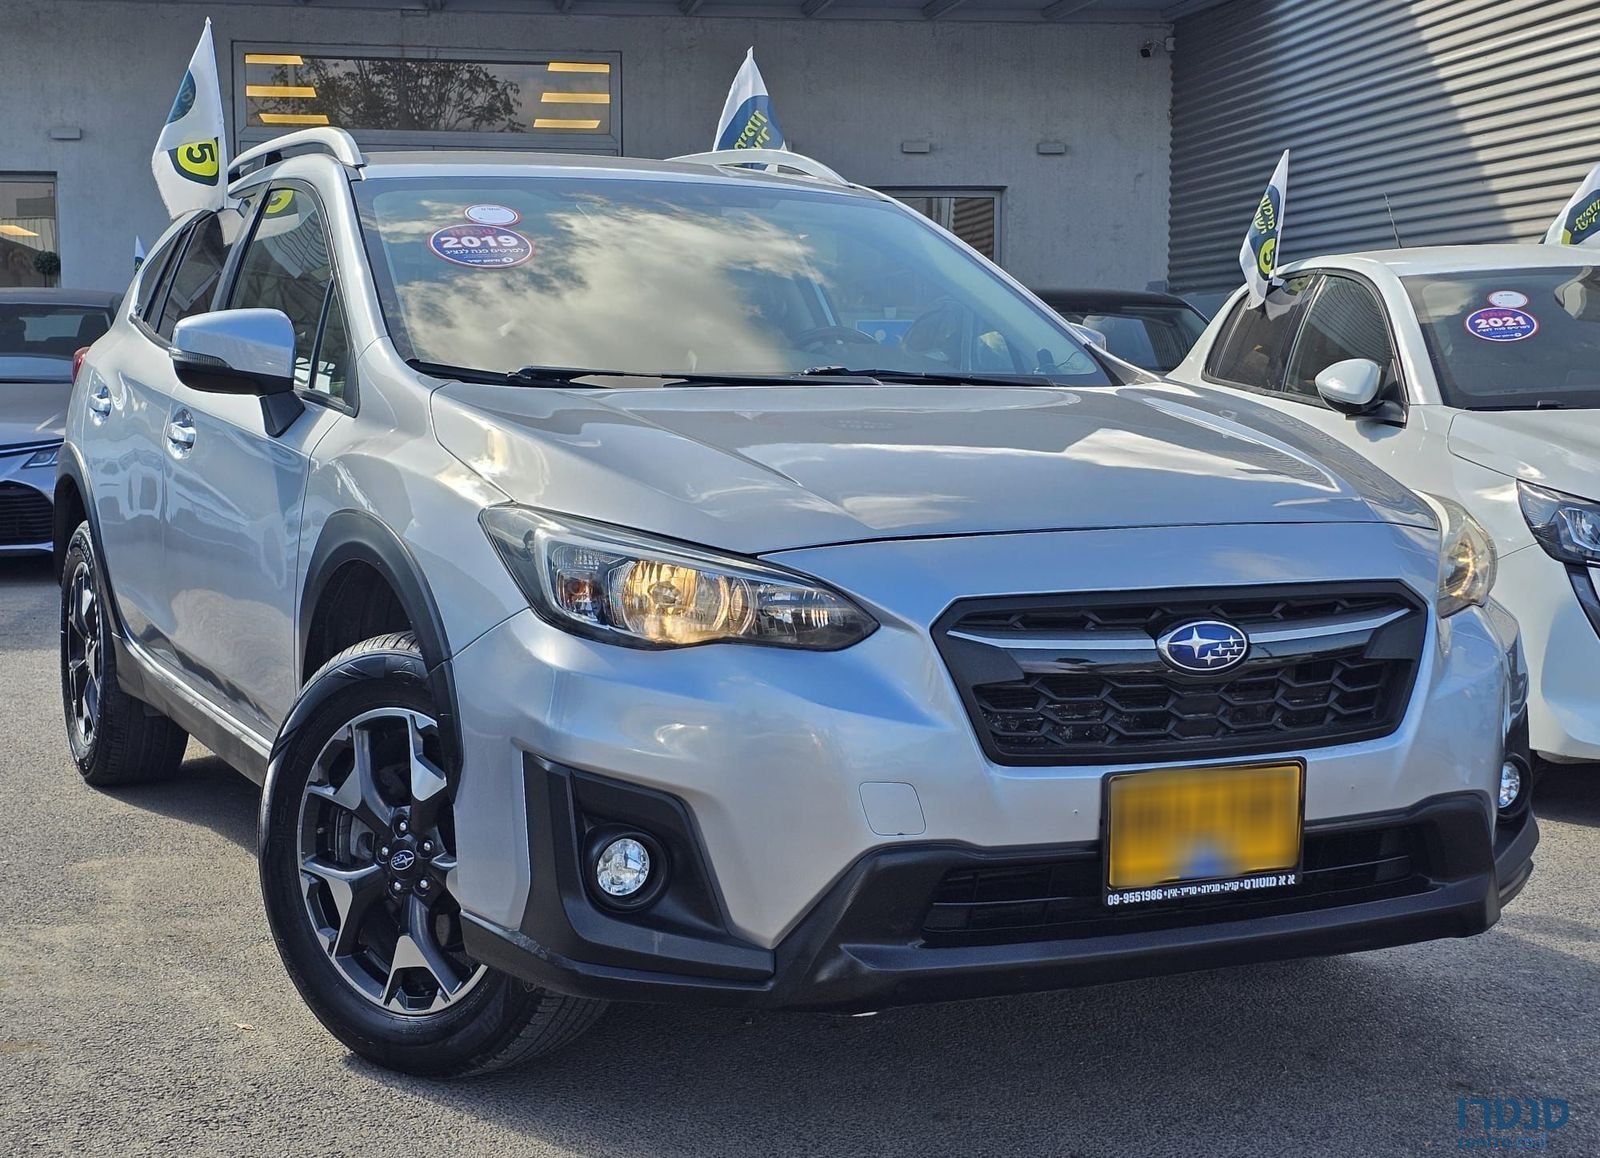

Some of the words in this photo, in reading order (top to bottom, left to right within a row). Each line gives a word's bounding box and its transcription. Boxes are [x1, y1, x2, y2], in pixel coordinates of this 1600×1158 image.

[440, 235, 519, 249] 2019
[1474, 315, 1527, 329] 2021
[1244, 876, 1277, 890] מוטורס
[1278, 875, 1286, 886] א
[1287, 874, 1296, 885] א
[1201, 883, 1221, 894] מכירה
[1224, 881, 1240, 892] קניה
[1107, 889, 1163, 906] 09-9551986
